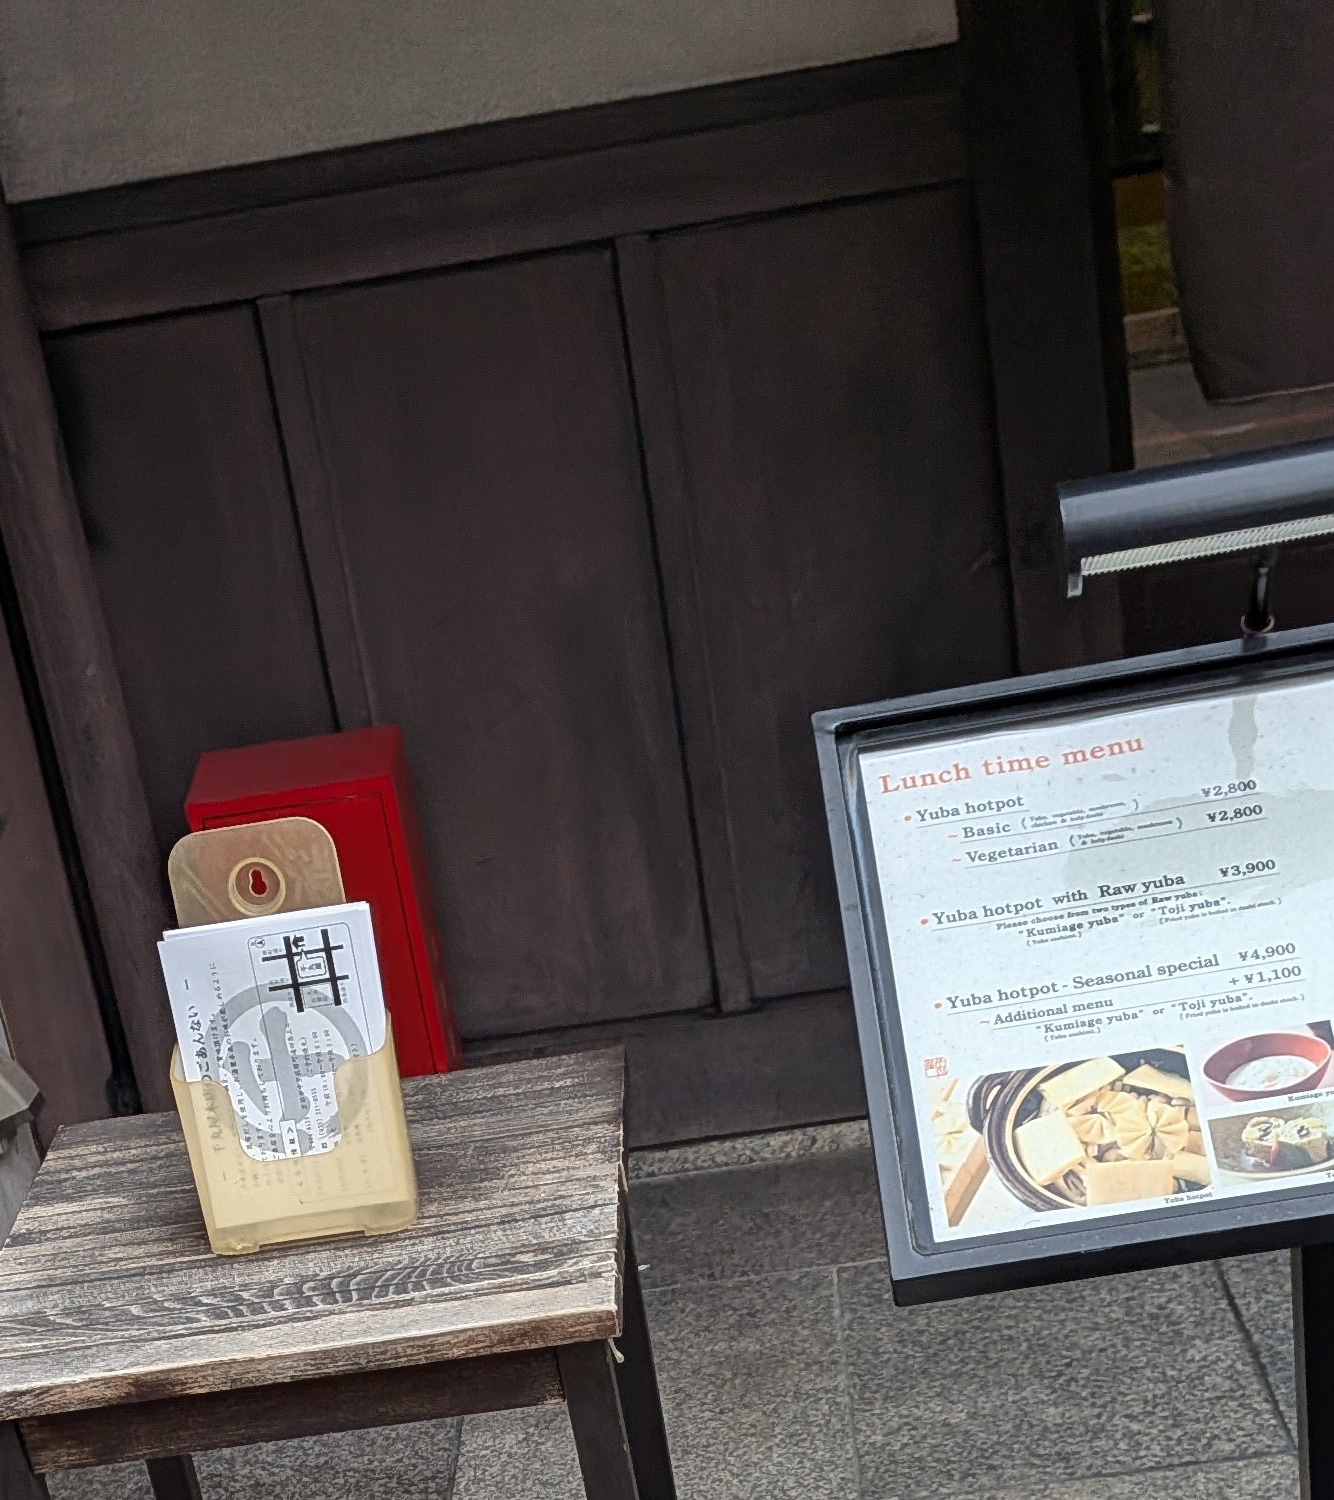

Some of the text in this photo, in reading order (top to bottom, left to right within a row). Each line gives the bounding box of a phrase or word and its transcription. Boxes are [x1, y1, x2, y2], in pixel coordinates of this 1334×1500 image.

[879, 738, 1144, 794] Lunch time menu
[916, 796, 1025, 822] Yuba hotpot
[962, 780, 1257, 838] Basic ¥2,800
[965, 805, 1263, 862] Vegetarian ¥2,800
[932, 860, 1275, 925] Yuba hotpot with Raw yuba ¥3,900
[996, 921, 1029, 930] Please
[1031, 914, 1065, 924] choose
[1067, 910, 1089, 918] from
[1111, 902, 1136, 912] types
[1151, 896, 1172, 904] Raw
[946, 993, 993, 1009] Yuba
[997, 982, 1059, 1002] hotpot
[1073, 965, 1153, 989] Seasonal
[1157, 954, 1220, 976] special
[1238, 943, 1296, 962] ¥4,900
[994, 1004, 1068, 1025] Additional
[1072, 1000, 1113, 1012] menu
[1288, 1092, 1323, 1102] Kumiage
[1186, 1192, 1213, 1200] hotpot
